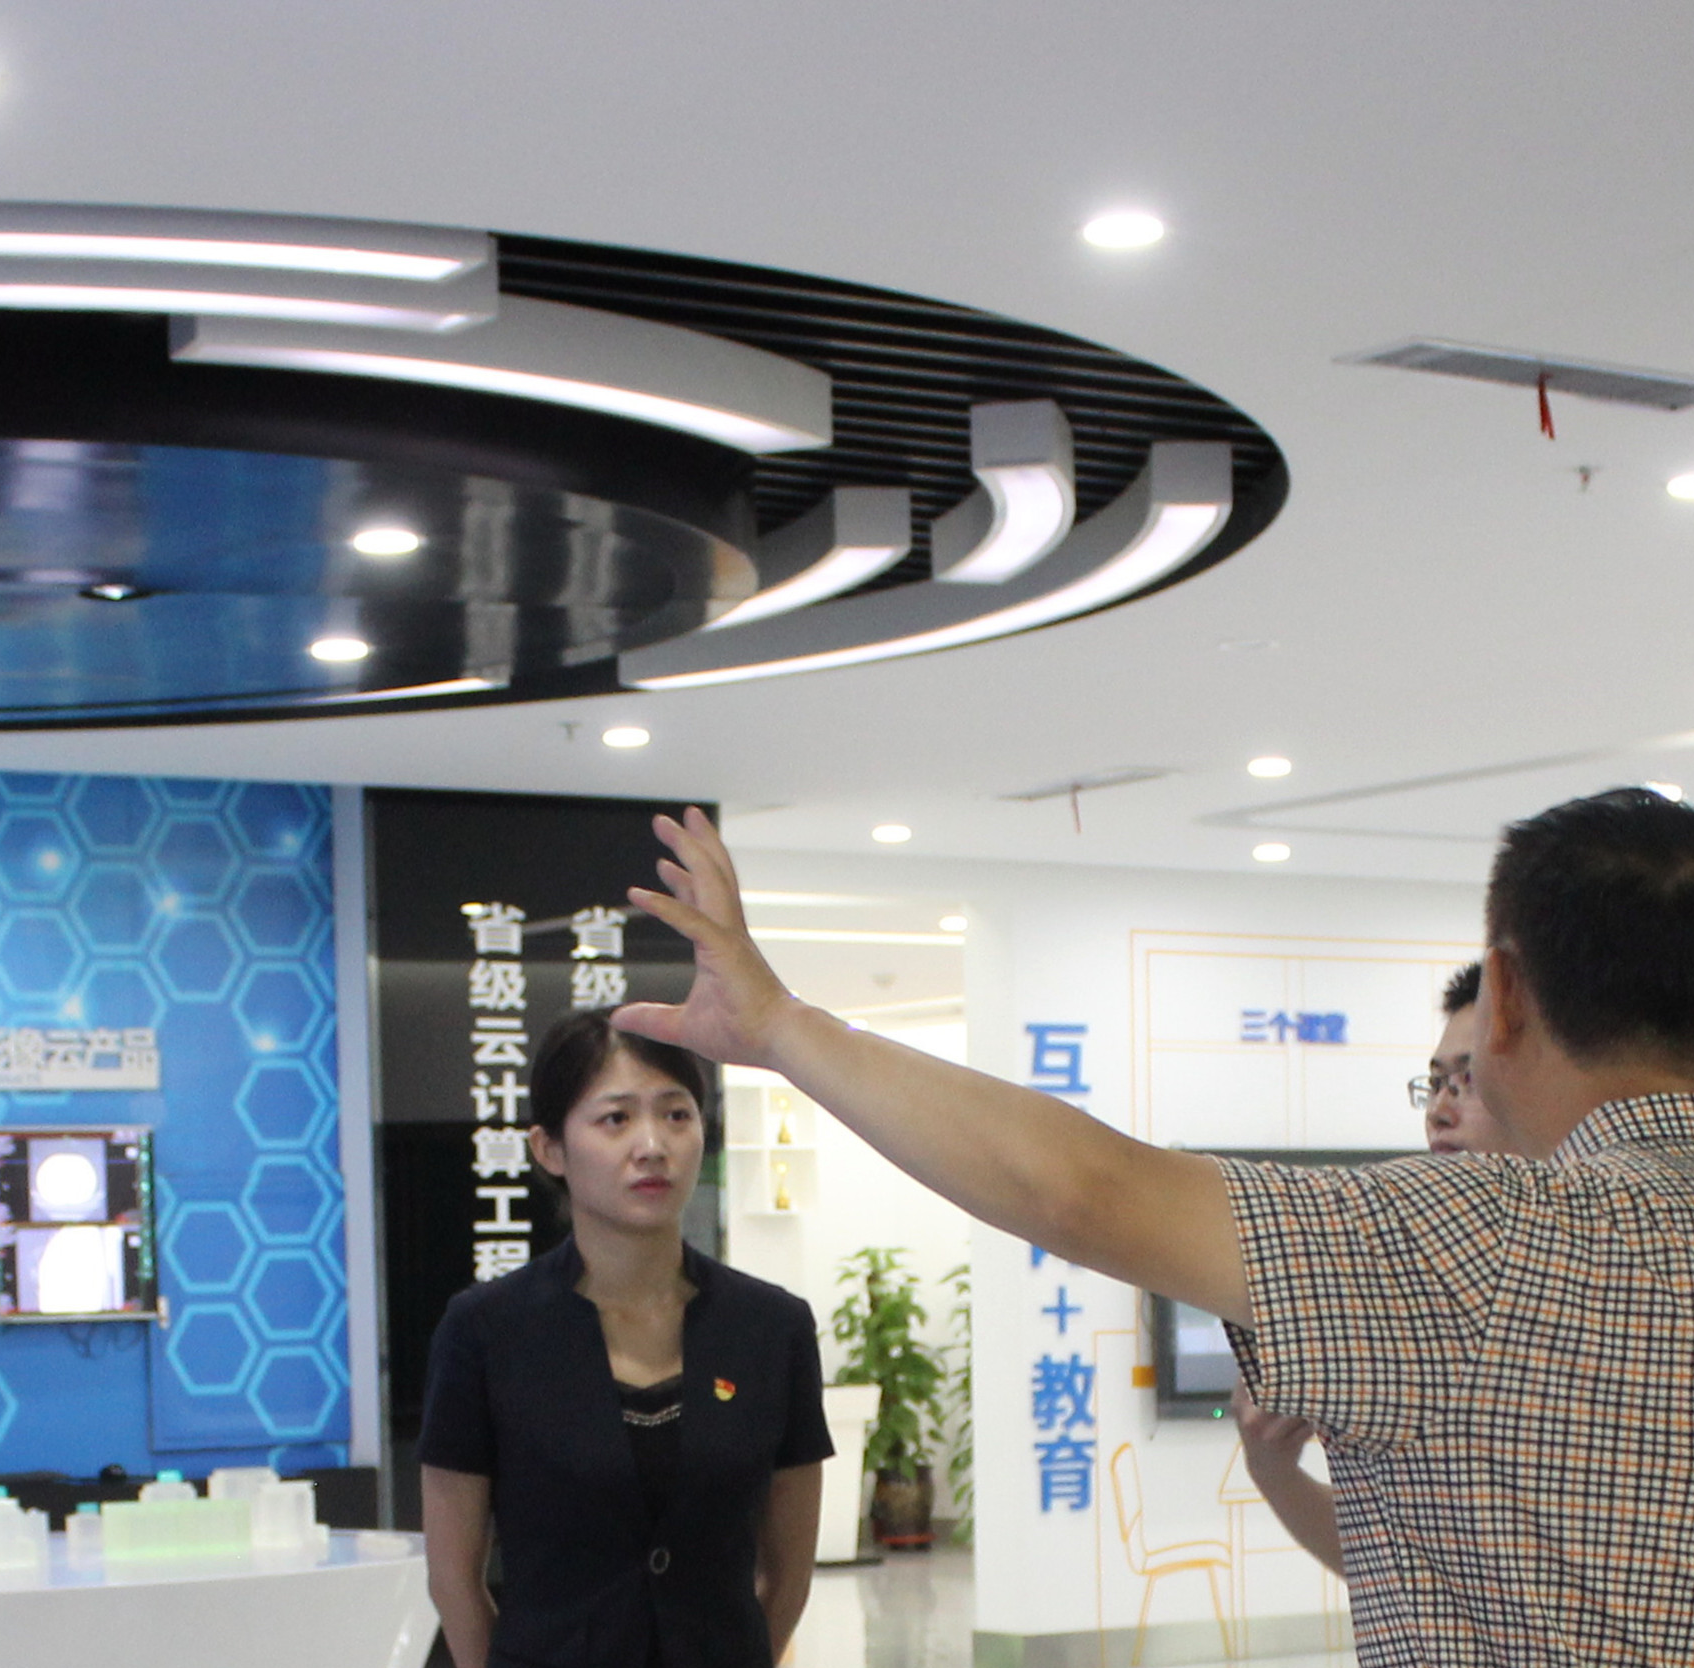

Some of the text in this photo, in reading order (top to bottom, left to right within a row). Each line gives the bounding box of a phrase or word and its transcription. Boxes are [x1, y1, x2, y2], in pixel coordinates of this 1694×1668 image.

[468, 902, 532, 1282] 省级云计算工程
[570, 905, 628, 1010] 省级
[1024, 1023, 1097, 1514] 互+教育
